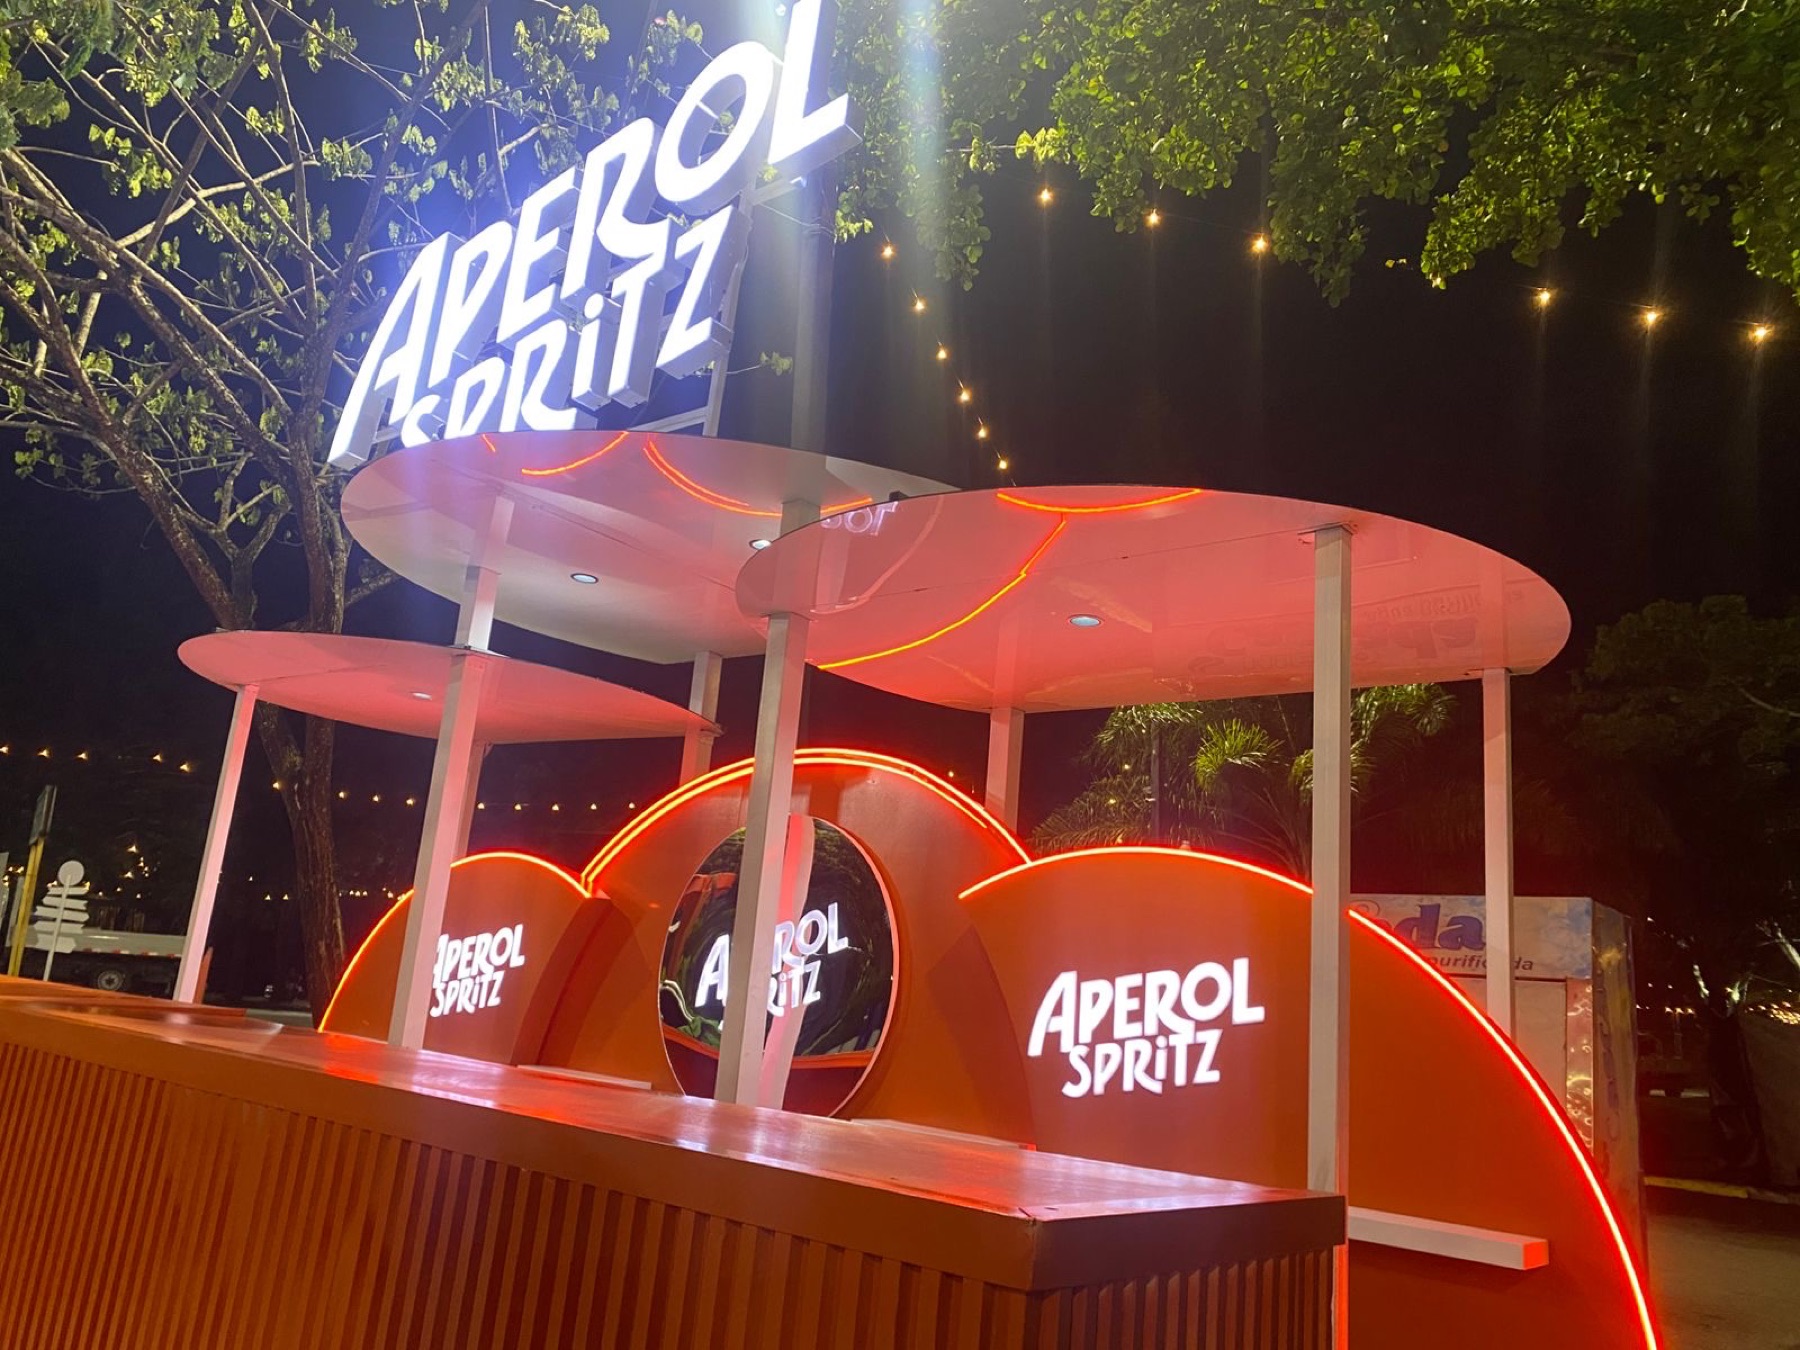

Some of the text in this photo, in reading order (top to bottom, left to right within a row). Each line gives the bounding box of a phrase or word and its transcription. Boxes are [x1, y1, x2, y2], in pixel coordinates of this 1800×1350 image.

[328, 0, 849, 463] APEROL
[429, 970, 506, 1018] SPRiTZ
[694, 902, 849, 1008] AROL
[1027, 957, 1266, 1057] APEROL
[1061, 1028, 1224, 1099] SPRiTZ
